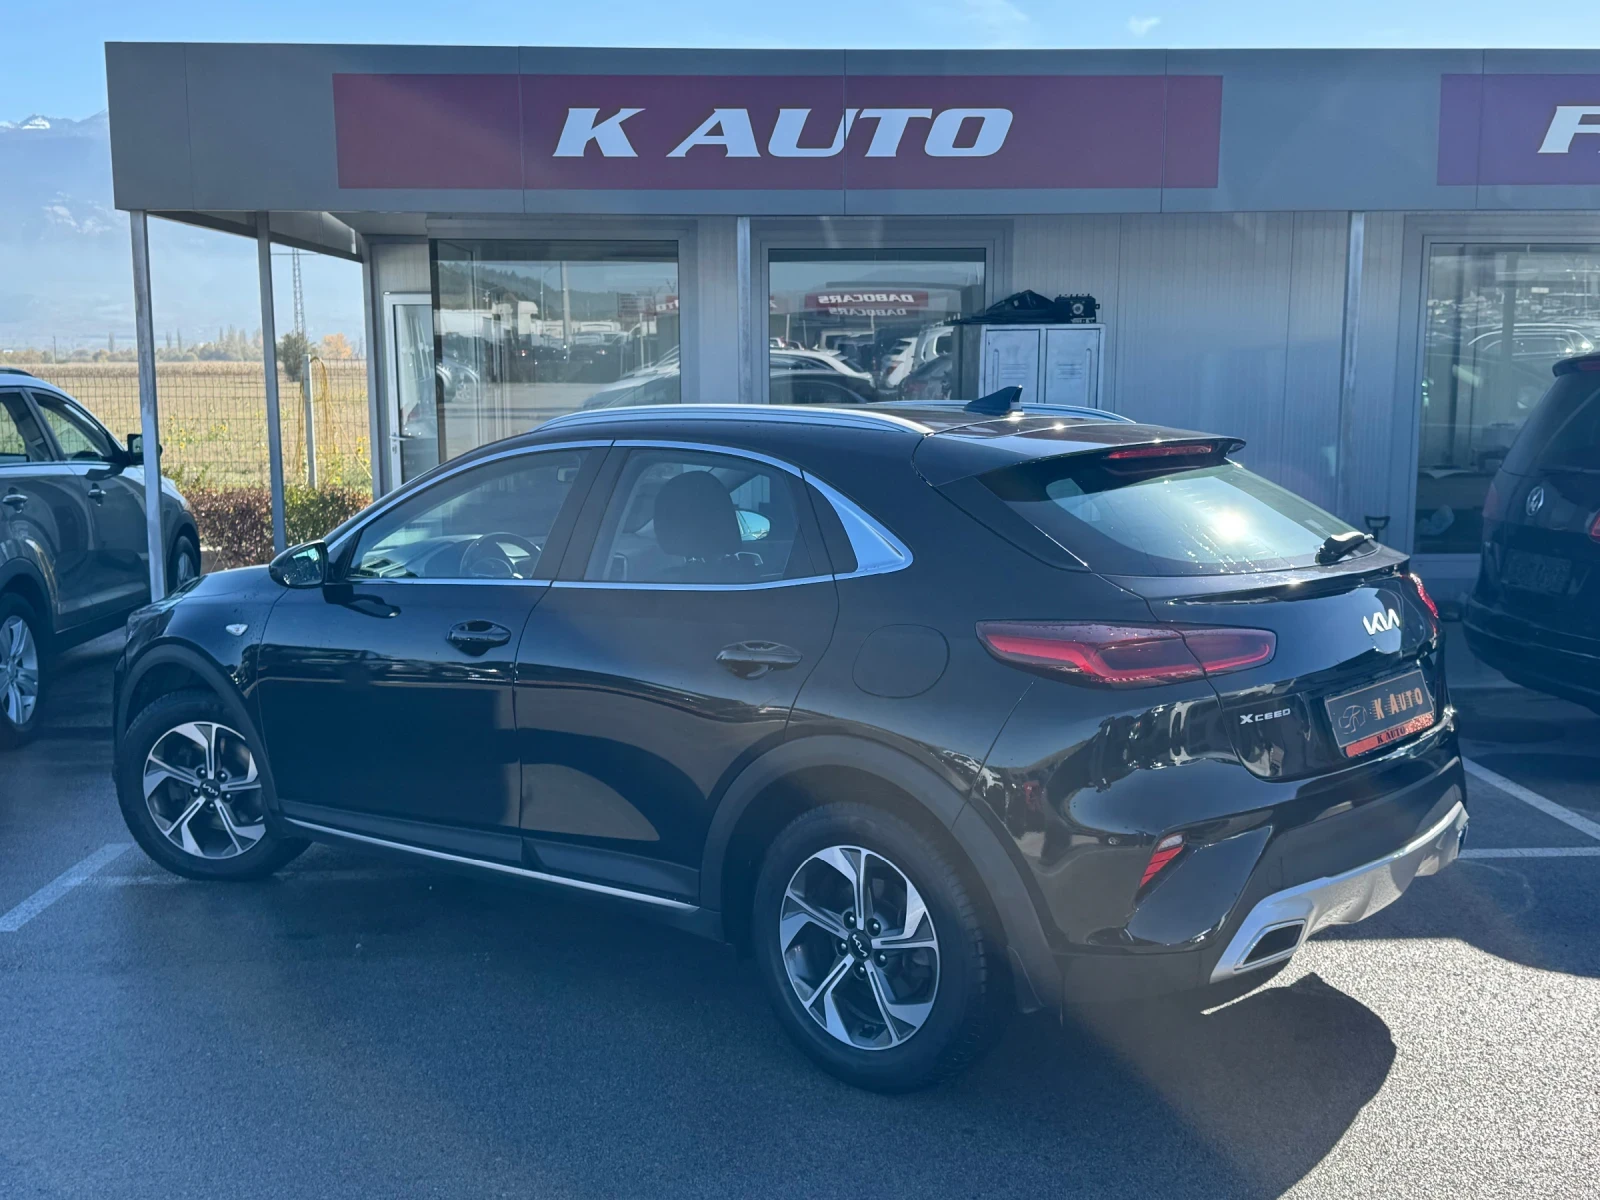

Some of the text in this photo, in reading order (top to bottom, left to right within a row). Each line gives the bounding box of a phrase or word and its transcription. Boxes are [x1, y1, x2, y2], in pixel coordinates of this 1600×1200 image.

[552, 108, 1013, 157] K AUTO
[1537, 106, 1600, 153] F
[1363, 608, 1400, 635] KIA
[1374, 688, 1423, 720] K AUTO
[1385, 726, 1406, 740] AUTO
